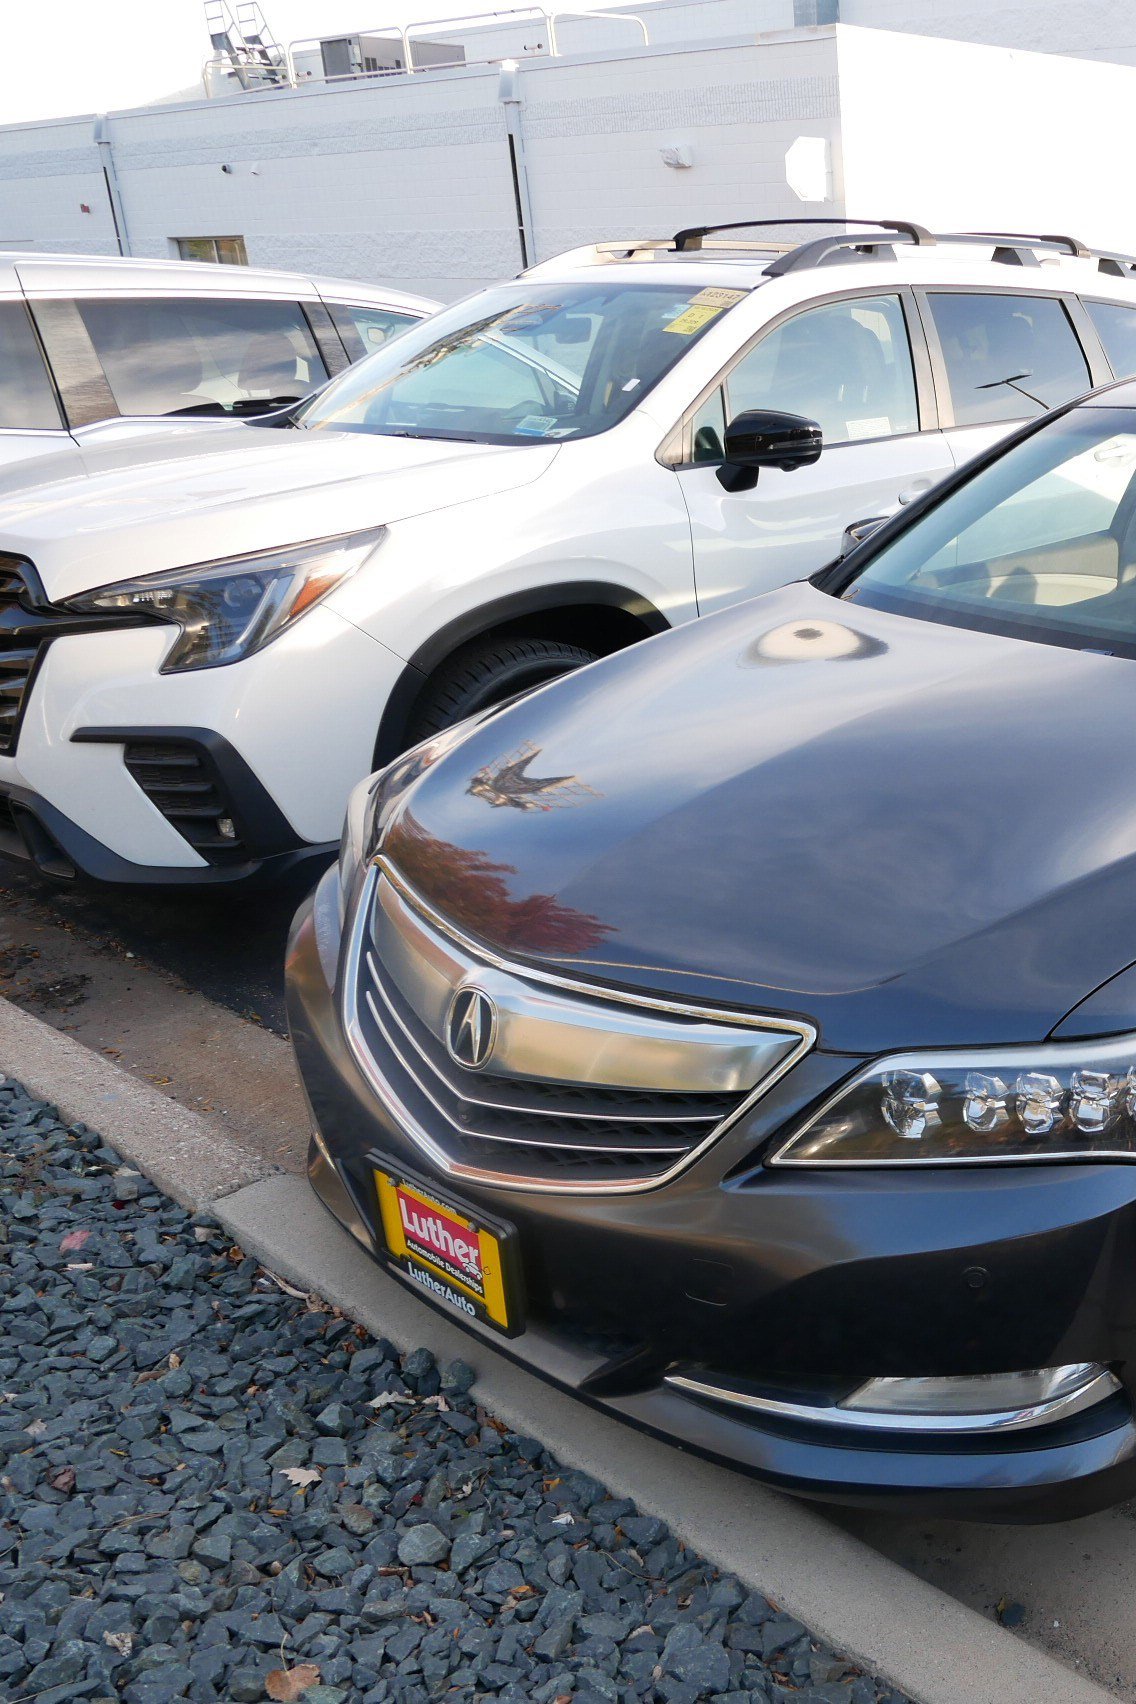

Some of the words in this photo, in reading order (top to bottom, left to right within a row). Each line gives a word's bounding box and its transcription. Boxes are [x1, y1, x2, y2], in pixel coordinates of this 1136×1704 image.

[399, 1197, 479, 1266] Luther
[406, 1239, 445, 1268] Automobile
[445, 1261, 484, 1294] Dealerships
[407, 1261, 476, 1316] LutherAuto
